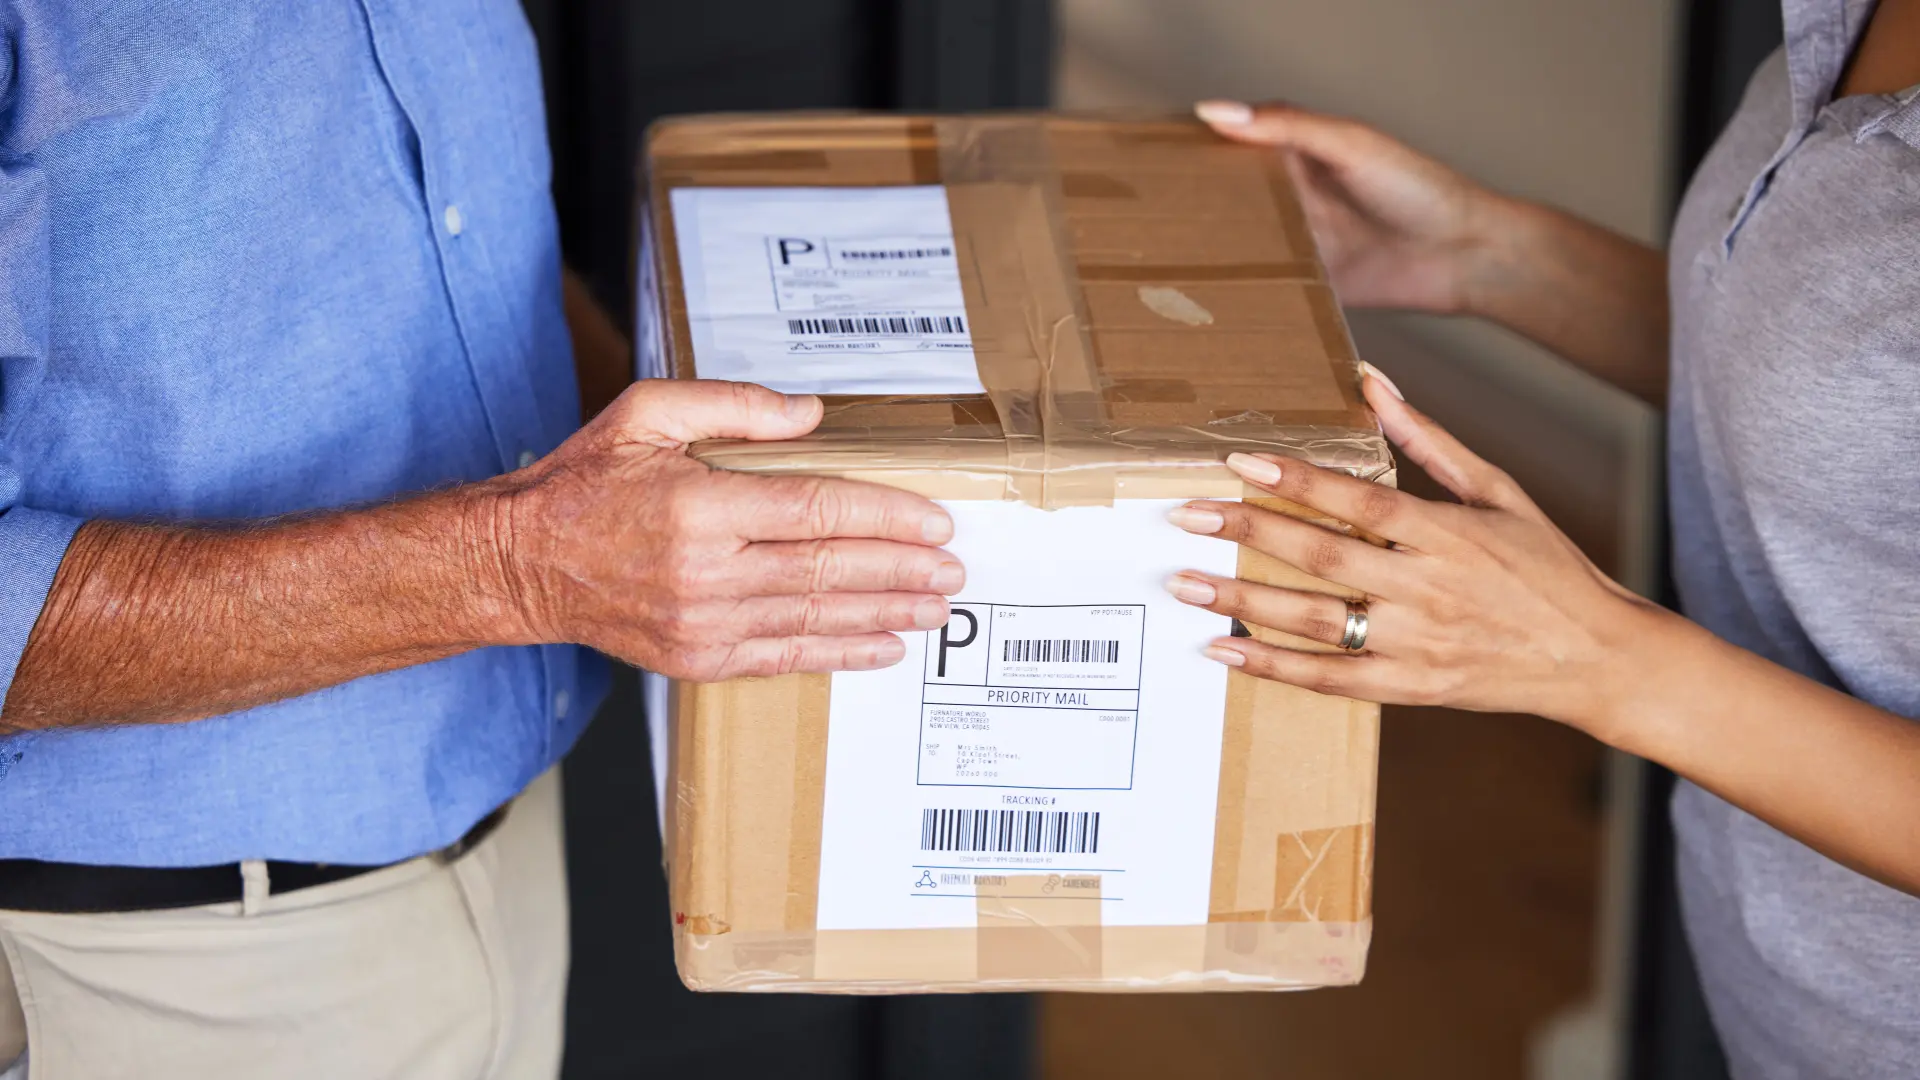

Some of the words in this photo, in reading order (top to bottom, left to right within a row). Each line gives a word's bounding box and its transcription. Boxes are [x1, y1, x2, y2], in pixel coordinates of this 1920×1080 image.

[778, 237, 815, 265] P
[937, 608, 978, 677] P
[987, 690, 1050, 704] PRIORITY
[1055, 692, 1089, 706] MAIL
[1002, 795, 1048, 806] TRACKING
[1051, 797, 1056, 805] #
